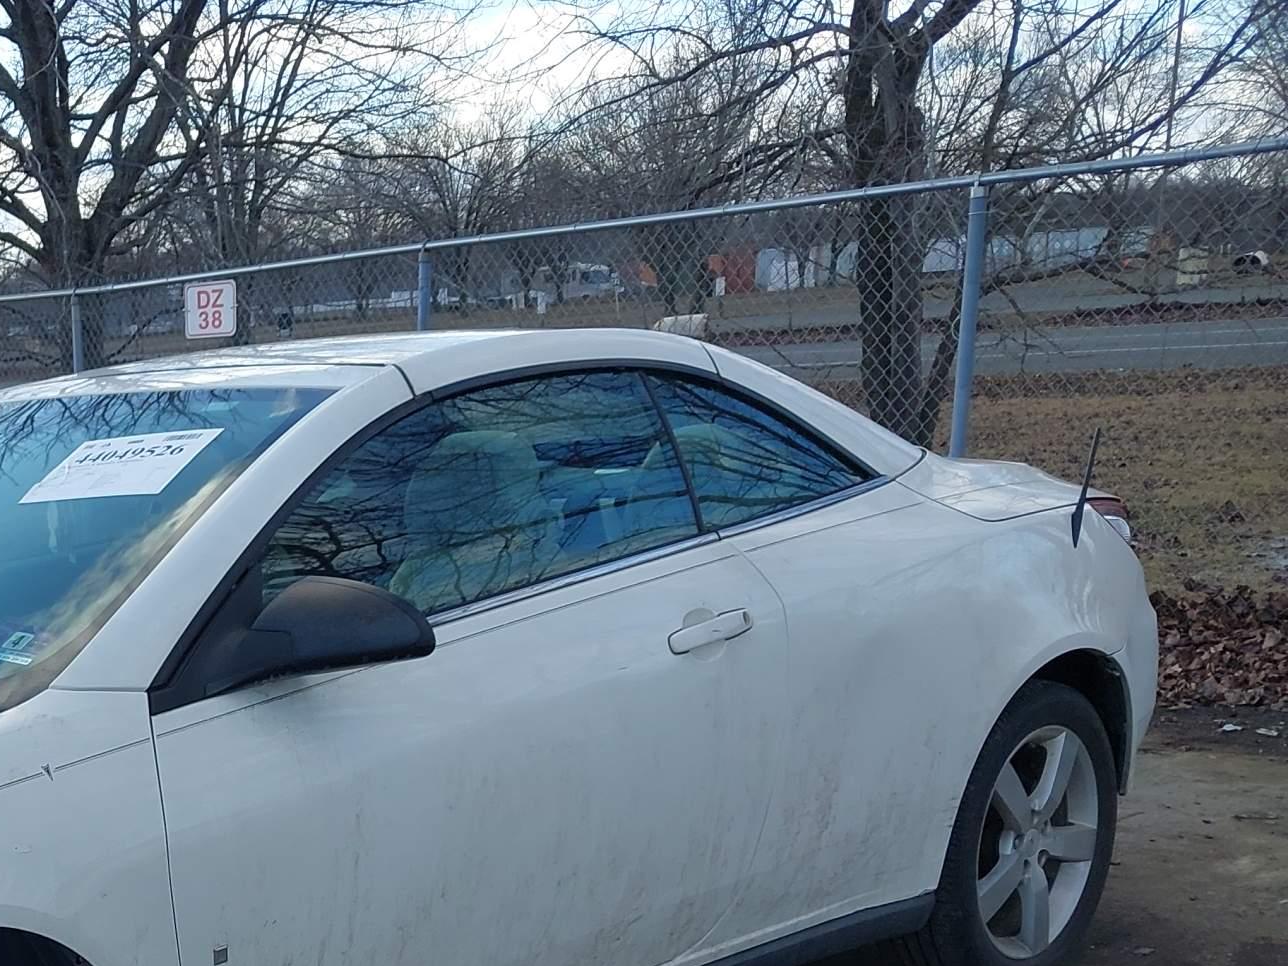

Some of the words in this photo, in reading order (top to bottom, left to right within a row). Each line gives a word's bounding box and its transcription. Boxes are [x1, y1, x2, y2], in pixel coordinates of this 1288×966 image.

[197, 289, 224, 309] DZ
[199, 310, 222, 329] 38
[75, 444, 185, 464] 44049526
